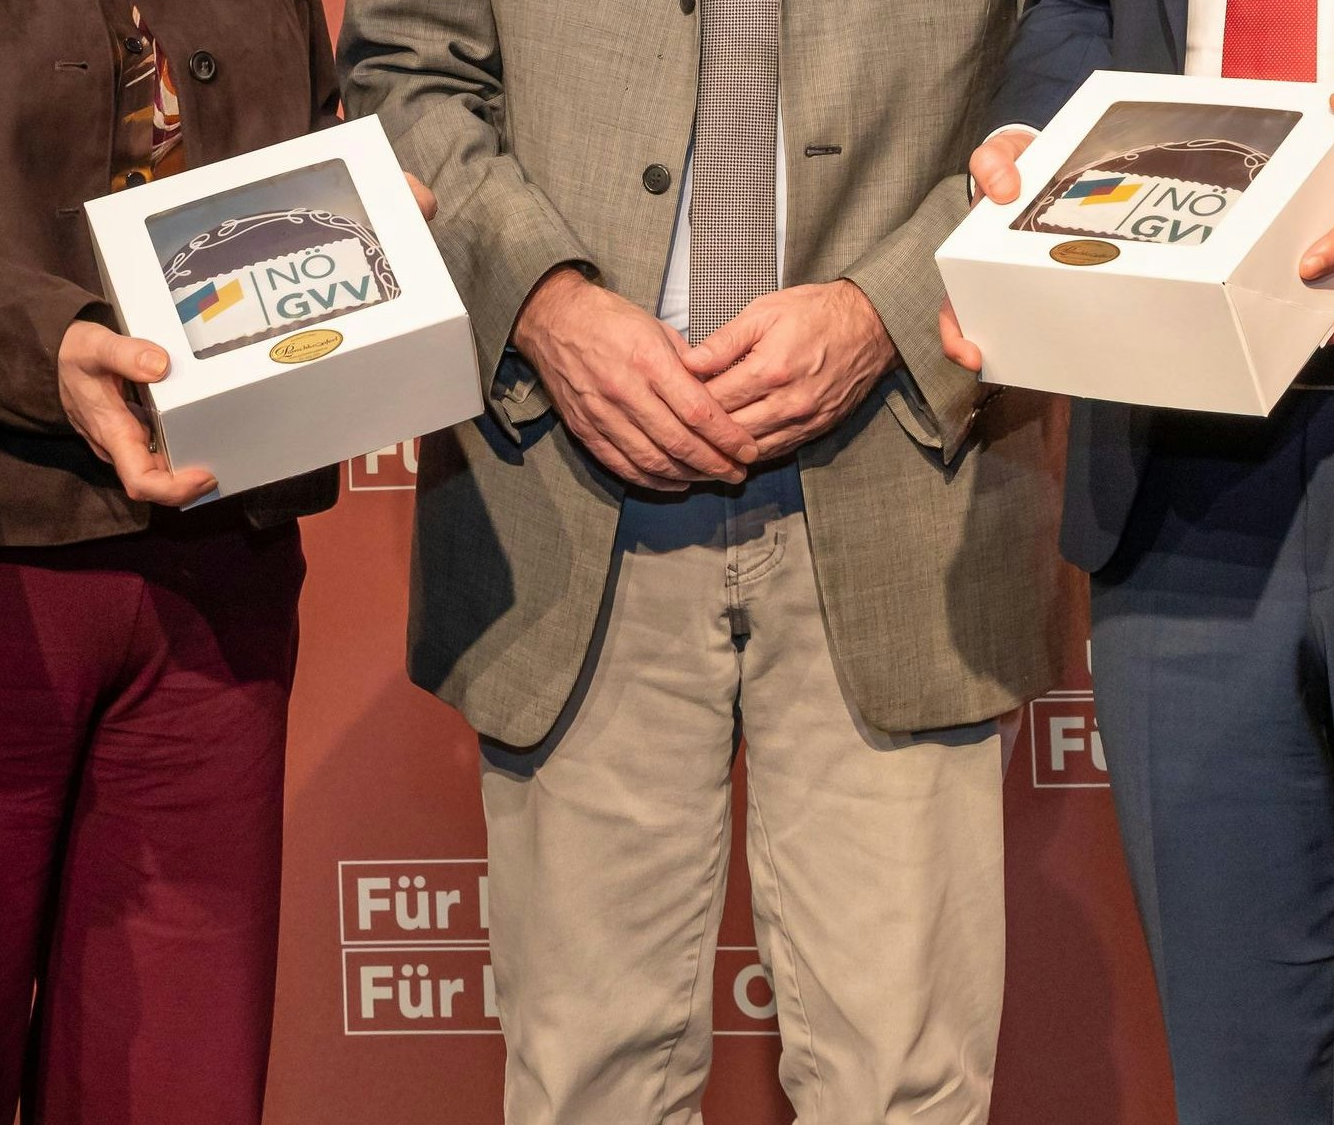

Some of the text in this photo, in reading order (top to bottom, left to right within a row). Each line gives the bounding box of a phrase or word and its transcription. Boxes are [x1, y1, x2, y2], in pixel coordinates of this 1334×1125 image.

[1152, 187, 1228, 217] NÖ
[265, 248, 336, 291] NÖ
[276, 275, 371, 319] GVV
[357, 875, 461, 931] Für
[360, 963, 465, 1019] Für
